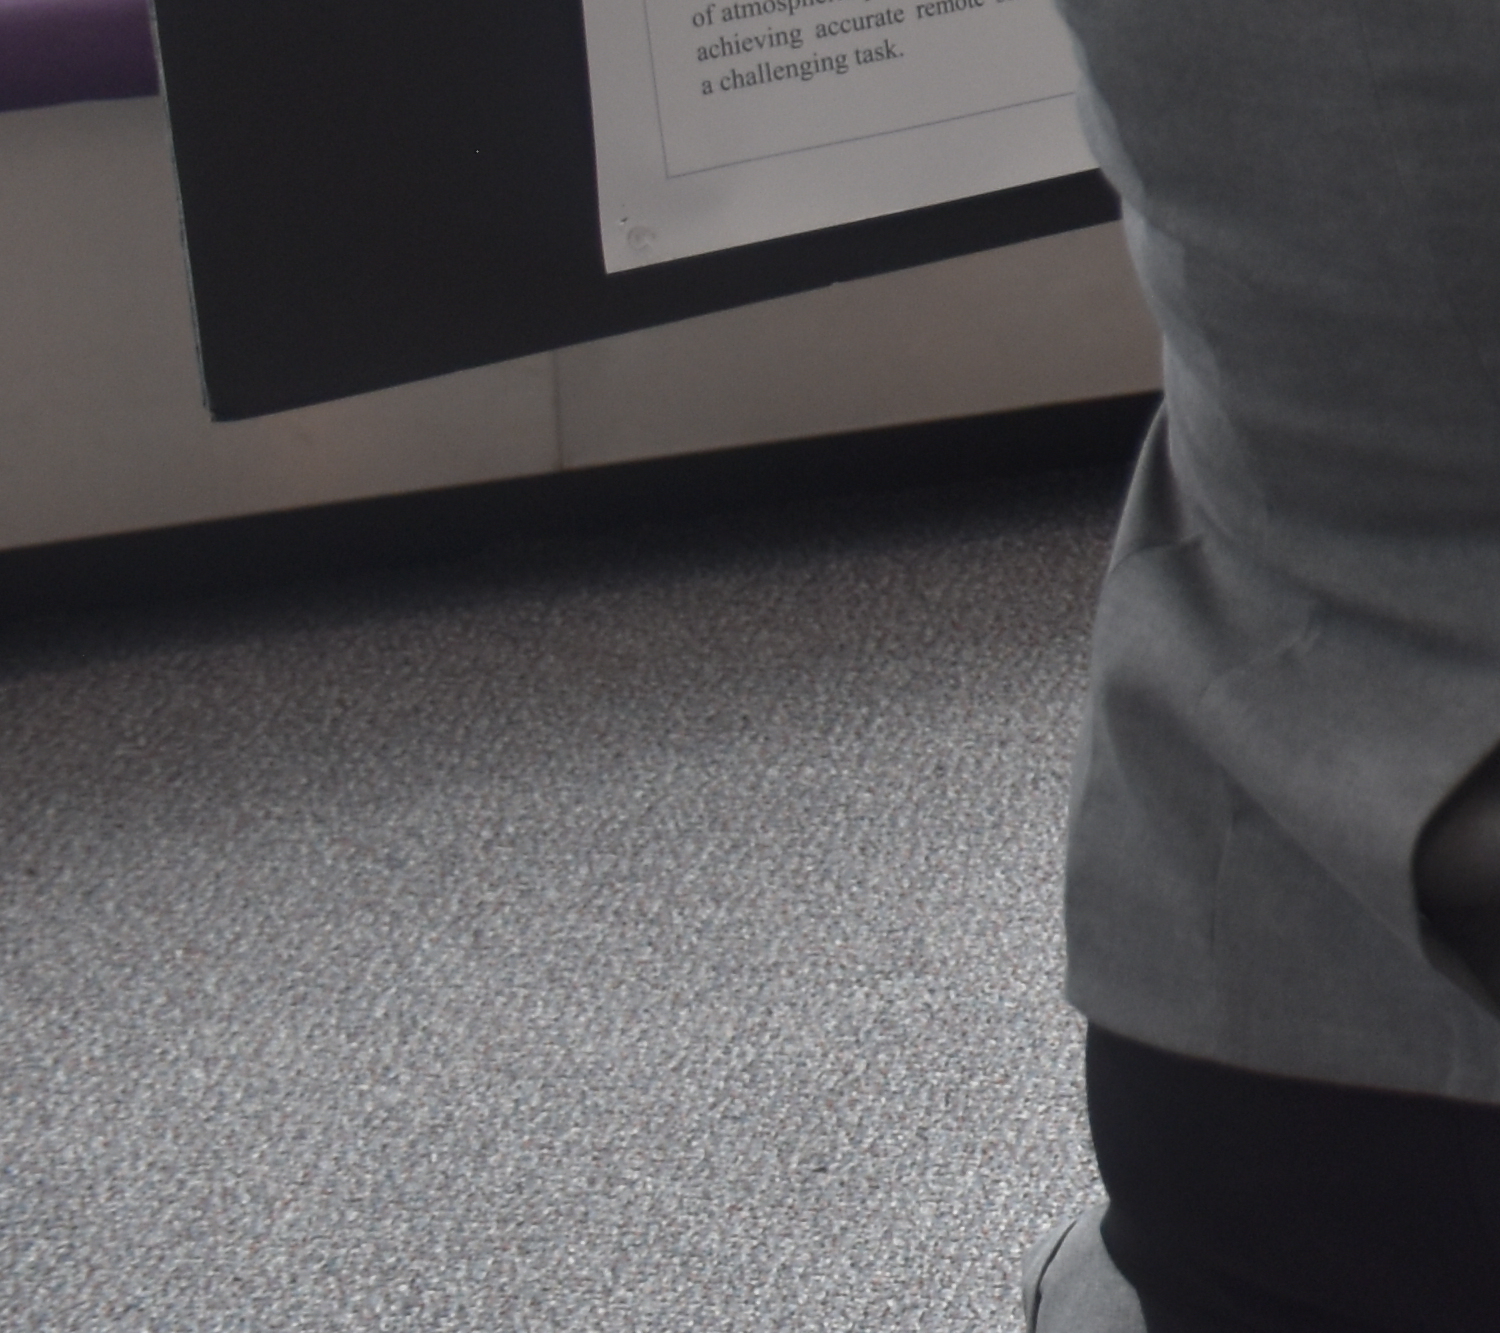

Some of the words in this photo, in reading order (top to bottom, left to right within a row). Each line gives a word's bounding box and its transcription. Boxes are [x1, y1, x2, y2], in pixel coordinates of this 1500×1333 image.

[702, 80, 714, 95] a
[720, 52, 849, 91] challenging
[854, 39, 904, 65] task.
